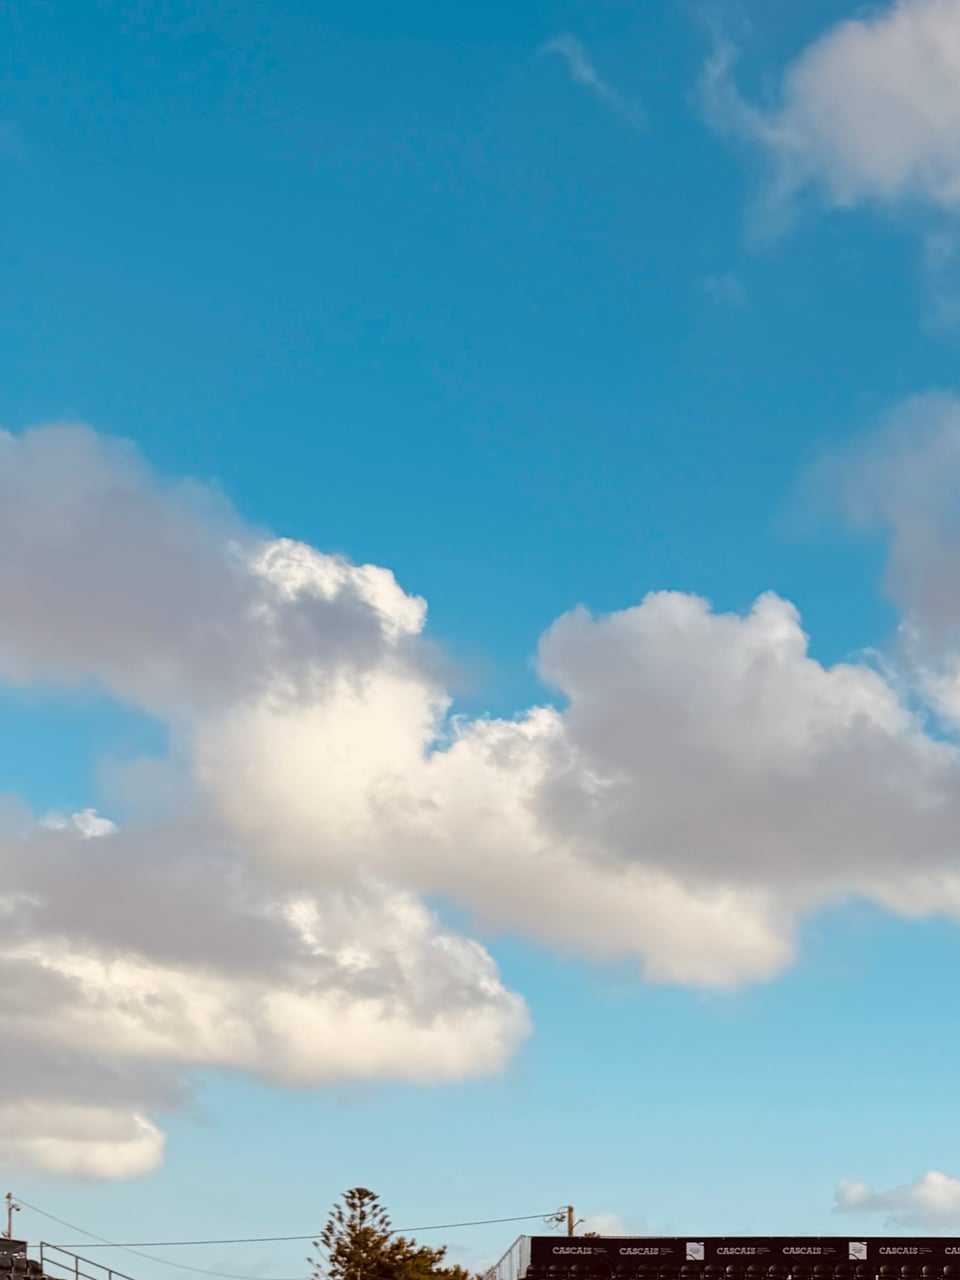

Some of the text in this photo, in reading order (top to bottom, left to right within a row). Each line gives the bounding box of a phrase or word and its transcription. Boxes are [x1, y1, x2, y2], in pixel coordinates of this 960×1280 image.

[552, 1247, 592, 1255] CASCAIS
[717, 1247, 756, 1255] CASCAIS
[782, 1247, 822, 1255] CASCAIS
[879, 1247, 918, 1255] CASCAIS
